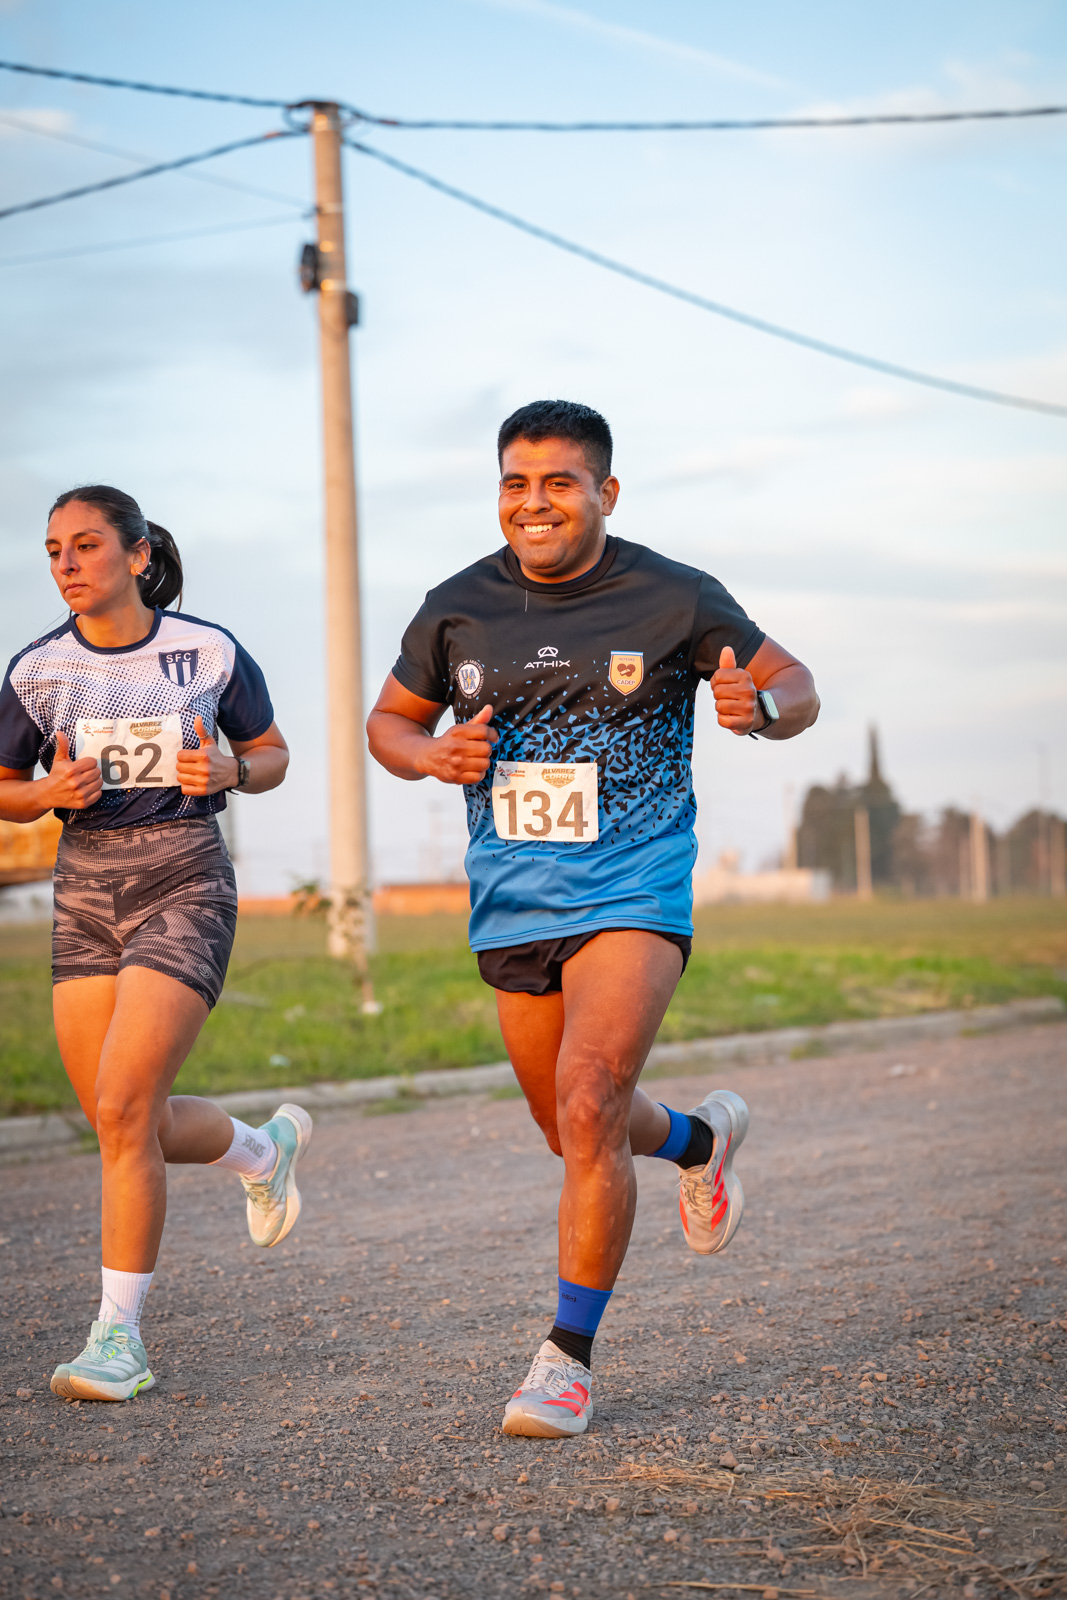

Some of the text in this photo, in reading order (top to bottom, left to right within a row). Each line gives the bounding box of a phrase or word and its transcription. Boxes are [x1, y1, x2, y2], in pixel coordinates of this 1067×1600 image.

[165, 652, 192, 664] SFC
[523, 660, 571, 670] ATHIX
[100, 742, 164, 786] 62
[499, 789, 589, 837] 134
